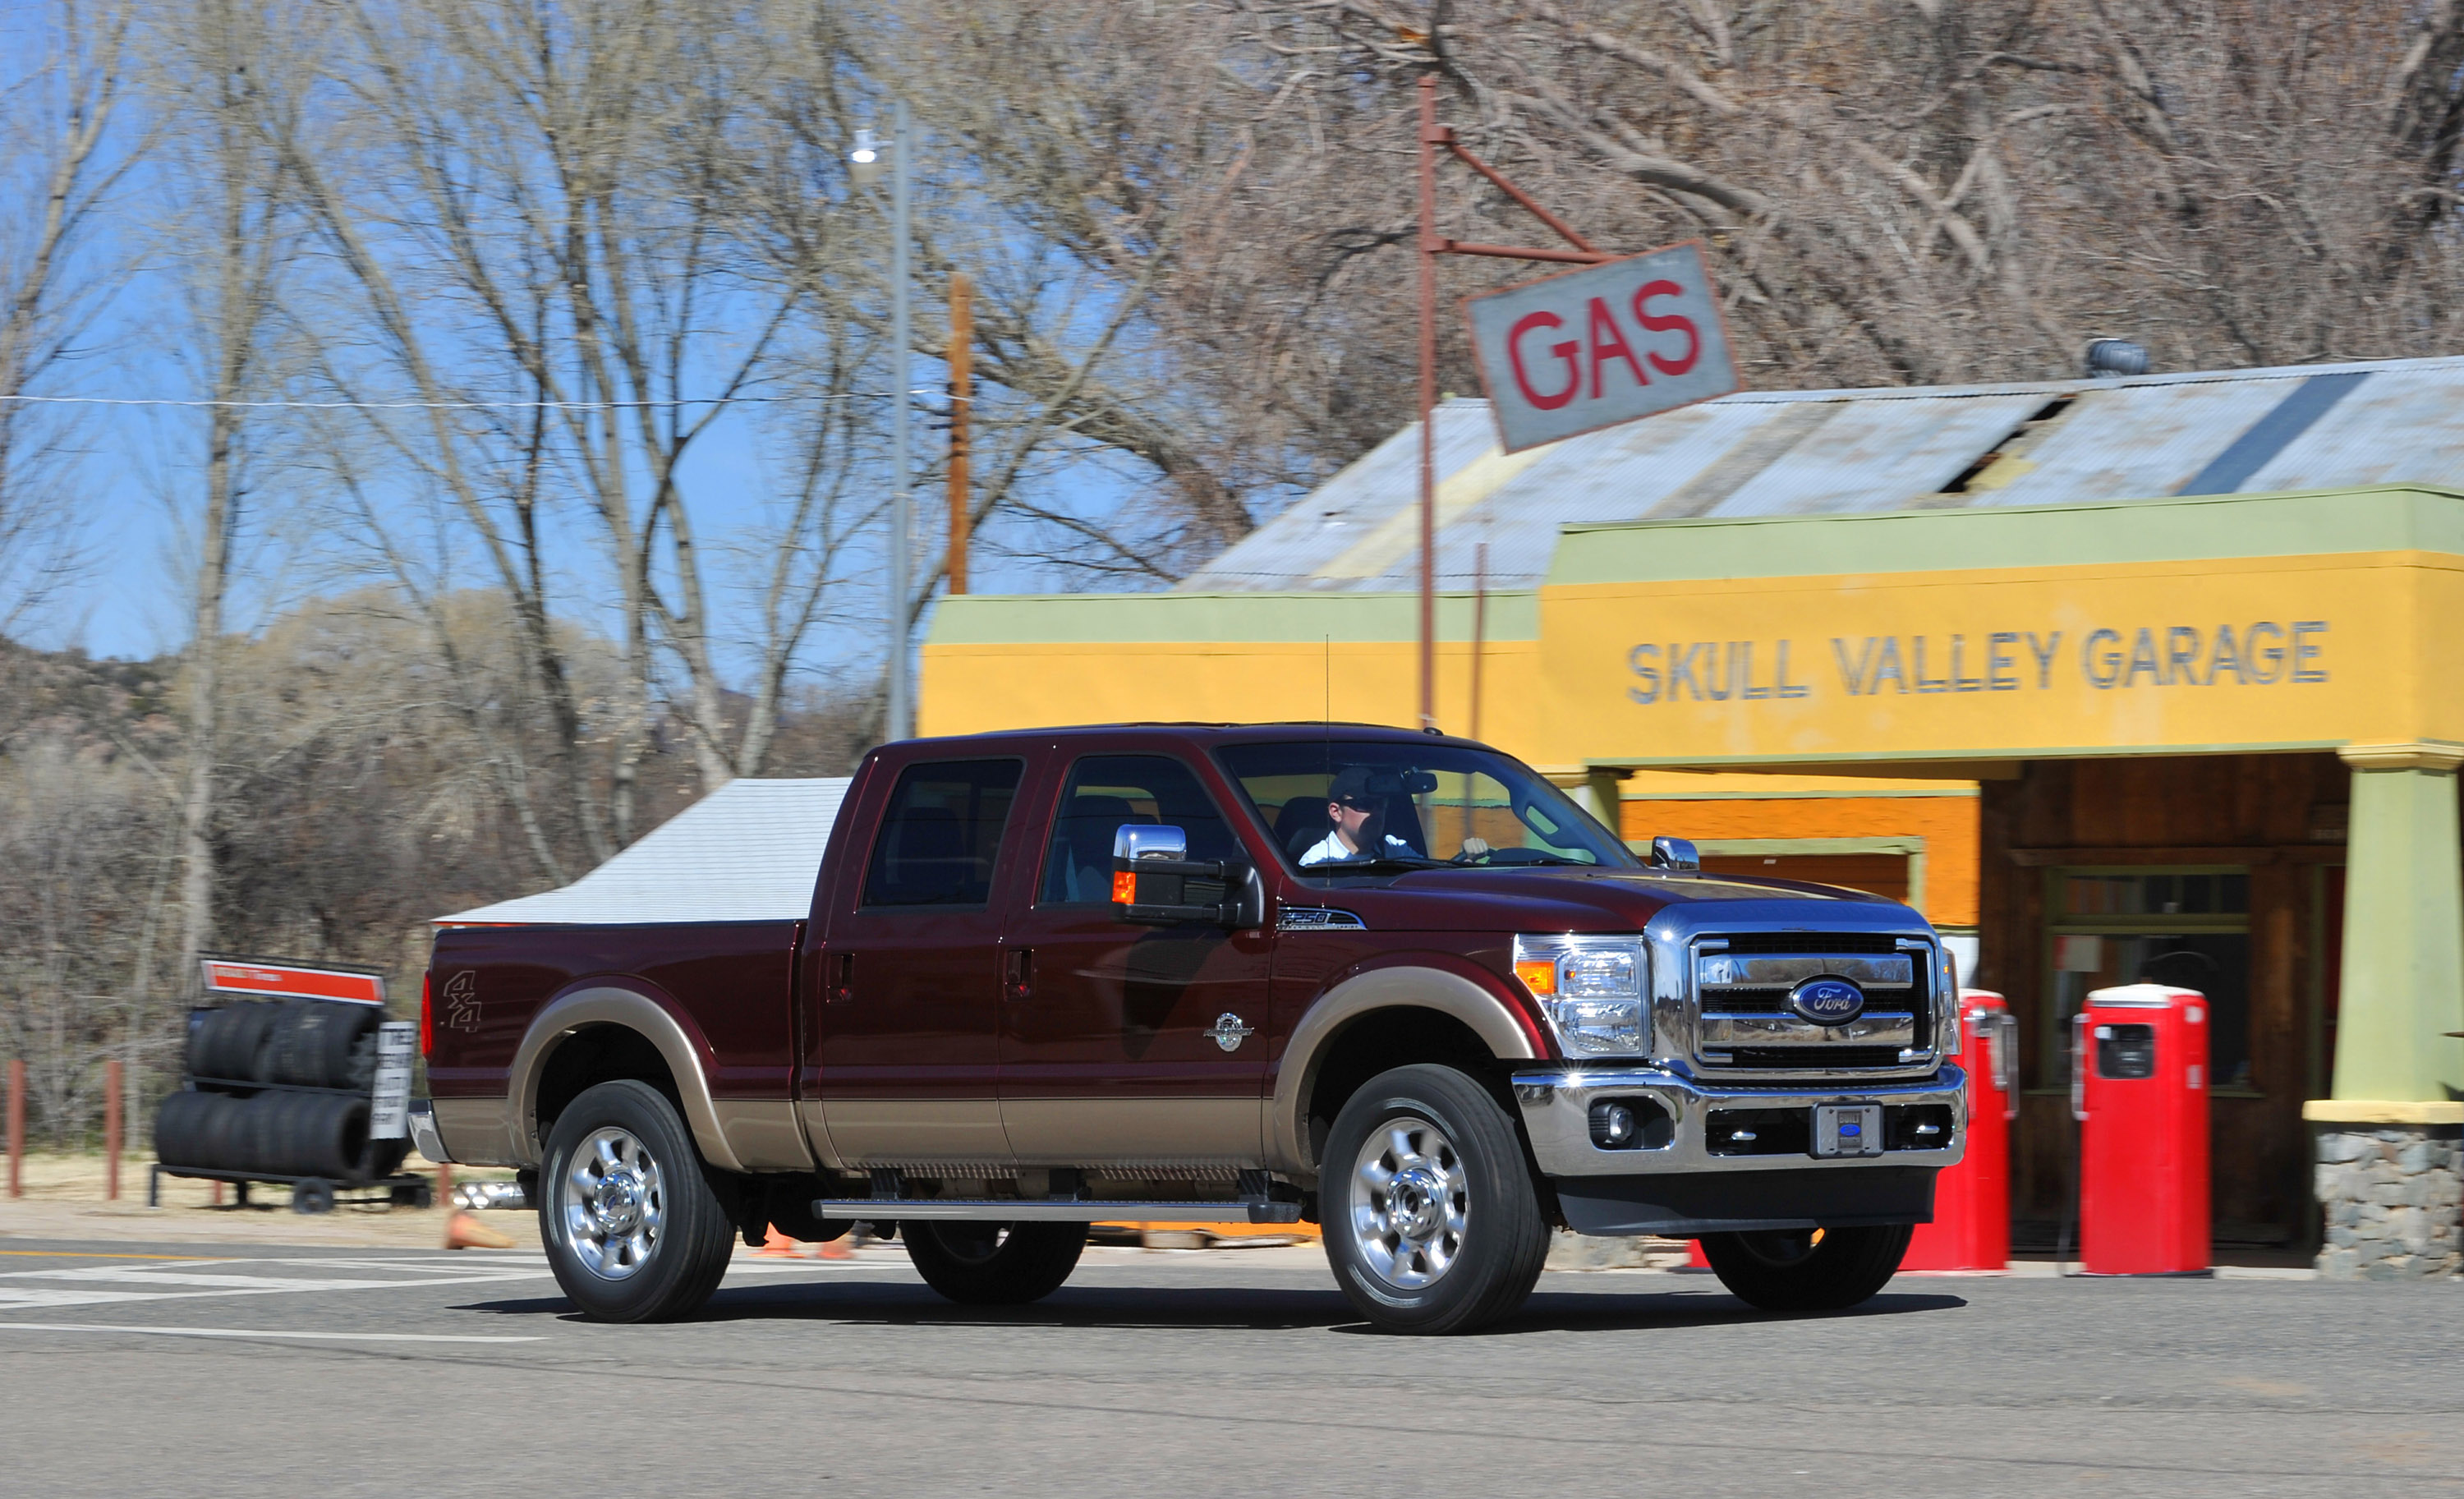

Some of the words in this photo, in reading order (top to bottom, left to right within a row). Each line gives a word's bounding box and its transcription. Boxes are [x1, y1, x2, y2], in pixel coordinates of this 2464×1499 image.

[1507, 279, 1701, 411] GAS
[1627, 639, 1810, 705] SKULL
[1830, 631, 2062, 696] VALLEY
[2080, 621, 2330, 689] GARAGE
[1814, 987, 1852, 1011] Ford
